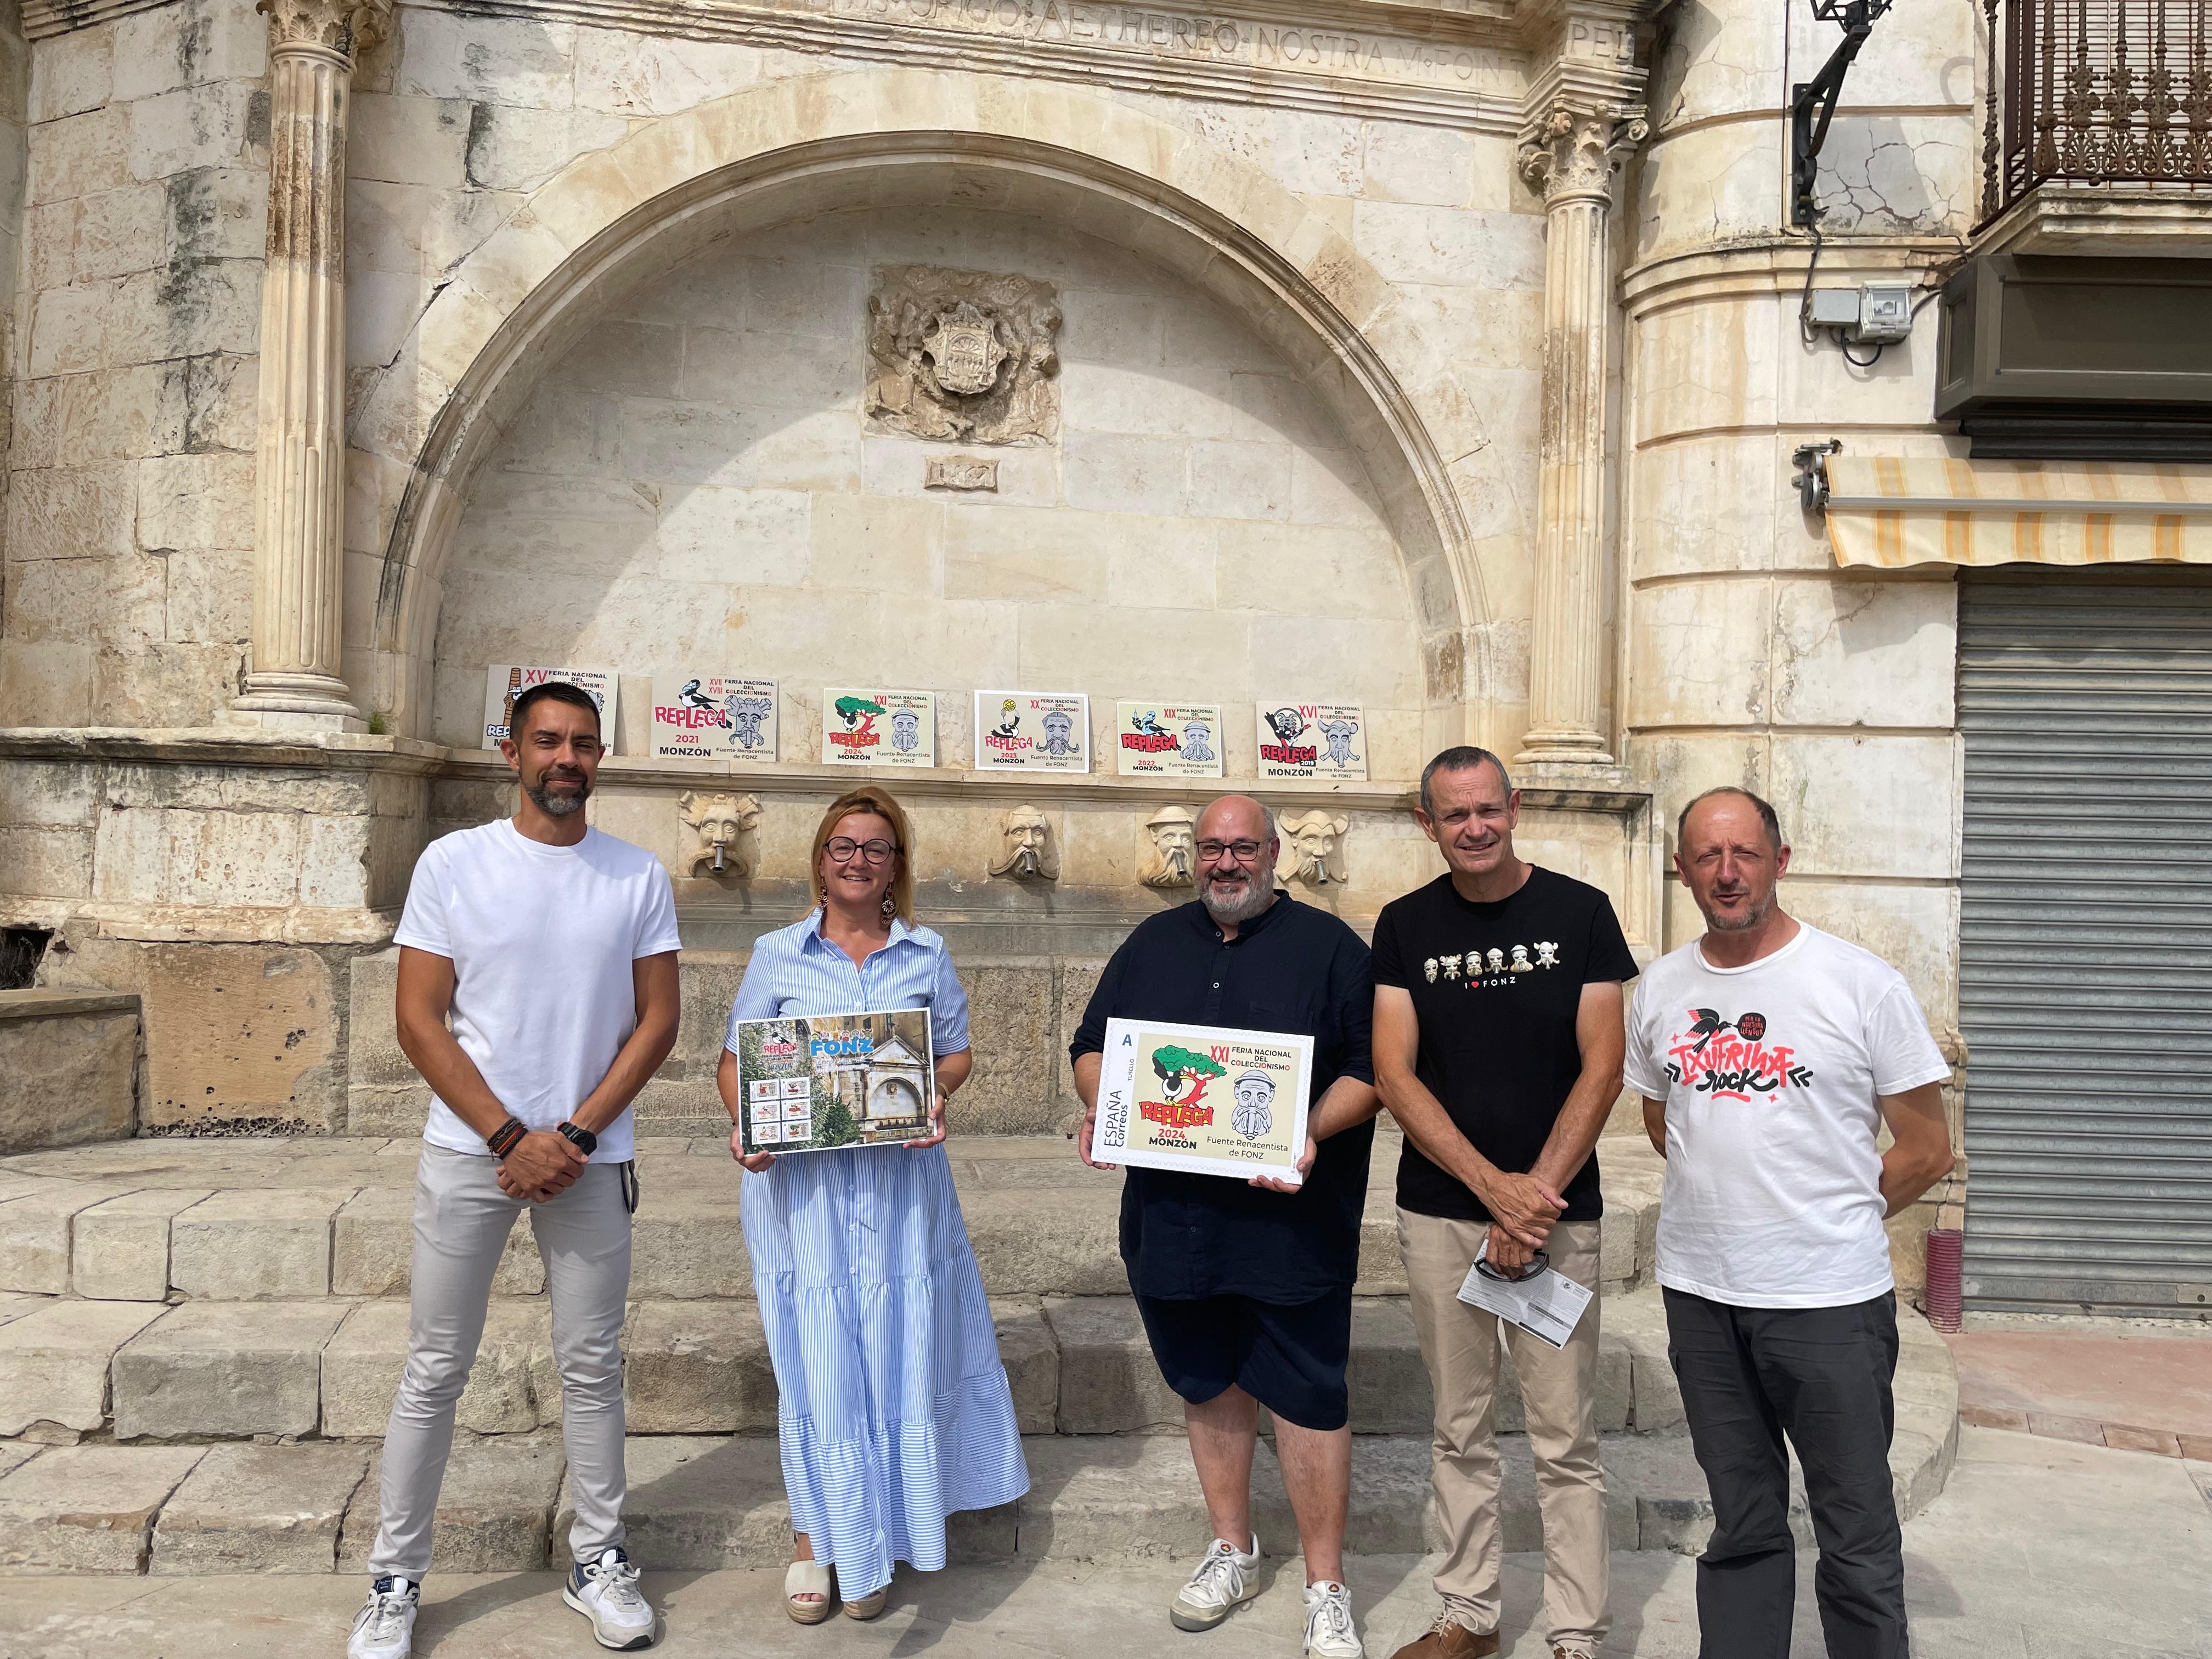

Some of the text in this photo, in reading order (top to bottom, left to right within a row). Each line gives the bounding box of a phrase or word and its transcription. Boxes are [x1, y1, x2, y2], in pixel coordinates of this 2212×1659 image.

[1035, 0, 1240, 54] AETHEREO
[1257, 26, 1421, 77] NOSTRAM
[525, 669, 548, 684] XV
[874, 695, 887, 705] XXI
[1031, 700, 1039, 709] XX
[655, 707, 726, 729] REPLEGA
[1164, 709, 1176, 718] XIX
[1299, 706, 1317, 719] XVI
[676, 735, 698, 743] 2021
[829, 732, 880, 748] REPLEGA
[985, 736, 1033, 751] REPLEGA
[1121, 733, 1177, 752] REPLEGA
[660, 747, 711, 757] MONZÓN
[1260, 745, 1317, 764] REPLEGA
[1268, 768, 1312, 776] MONZÓN
[1483, 977, 1516, 988] FONZ
[1740, 1027, 1763, 1036] LLENGUA
[1122, 1034, 1132, 1046] A
[764, 1043, 798, 1054] REPLEGA
[810, 1039, 873, 1057] FONZ
[1210, 1045, 1229, 1063] XXI
[1232, 1046, 1291, 1058] FERIA NACIONAL
[1231, 1059, 1290, 1071] COLECCIONISMO
[1104, 1090, 1122, 1147] ESPAÑA
[1139, 1101, 1214, 1128] REPLEGA
[1115, 1104, 1128, 1147] Correos
[1159, 1128, 1185, 1139] 2024
[1149, 1137, 1197, 1149] MONZÓN
[1207, 1136, 1288, 1152] Fuente Renacentista
[1242, 1150, 1264, 1160] FONZ
